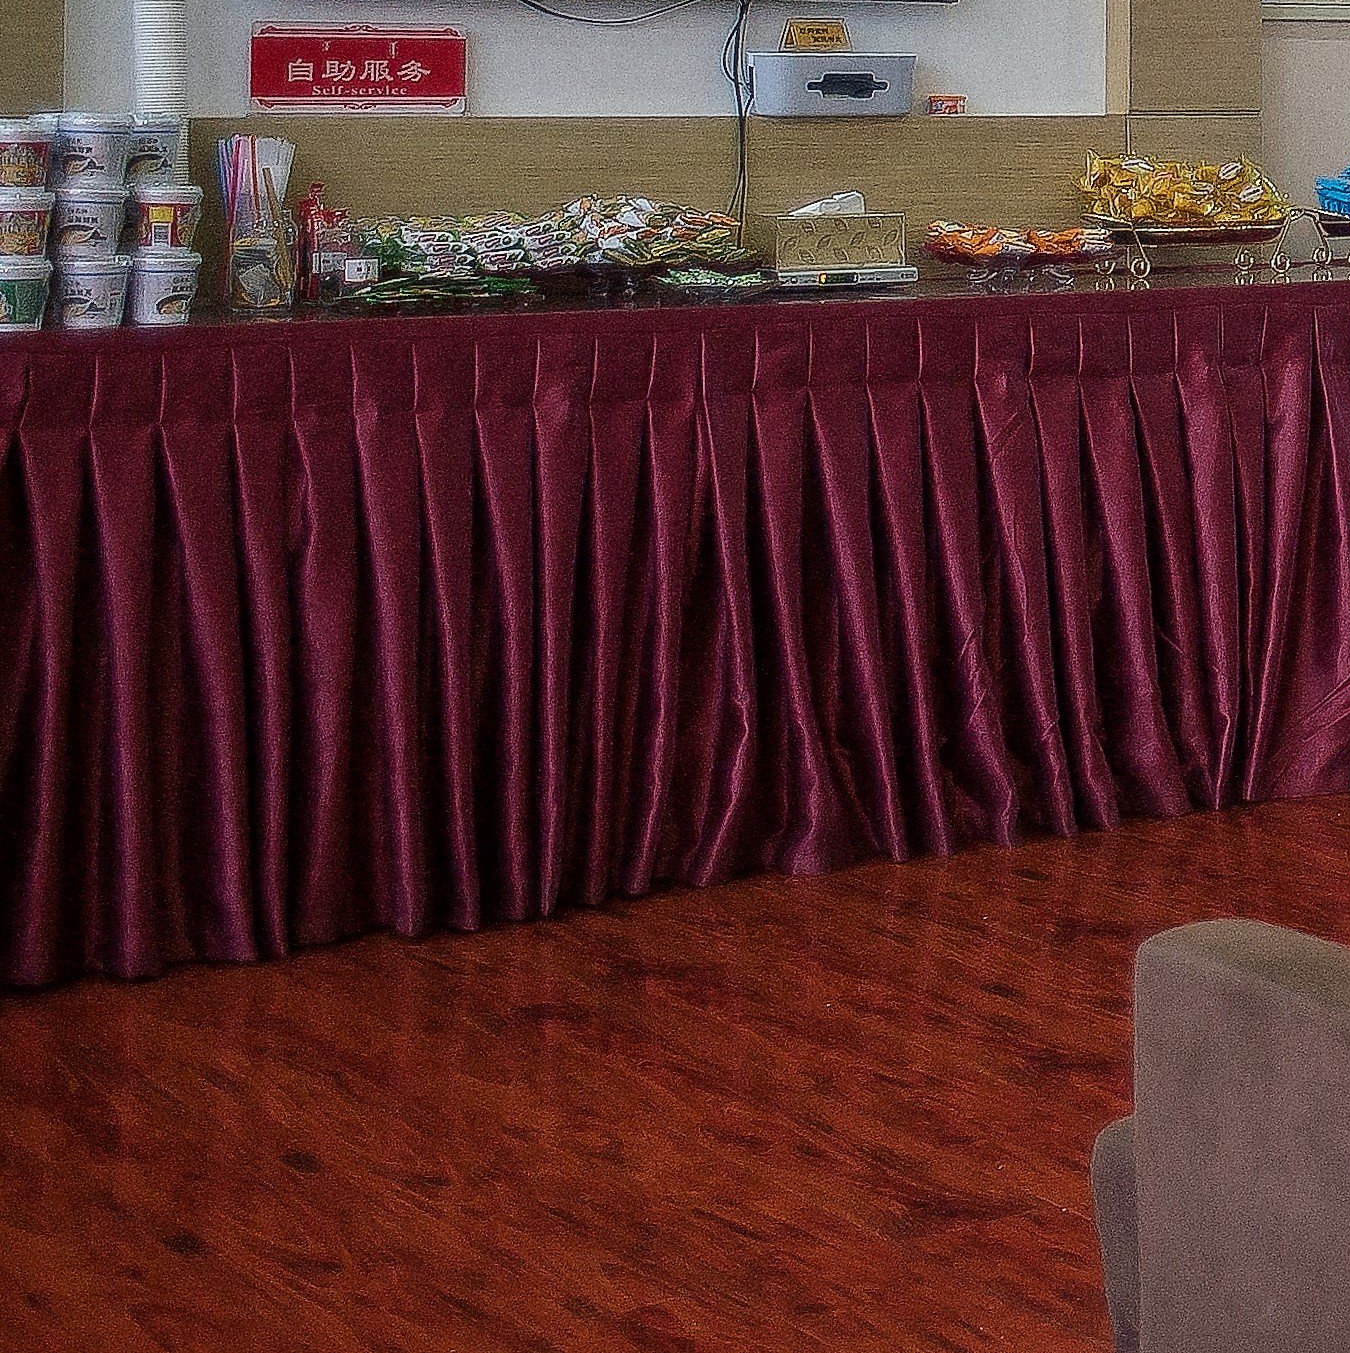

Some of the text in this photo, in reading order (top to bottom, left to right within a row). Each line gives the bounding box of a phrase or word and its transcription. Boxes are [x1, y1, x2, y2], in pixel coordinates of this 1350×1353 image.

[286, 58, 431, 82] 自助服务
[312, 85, 407, 96] Self-service
